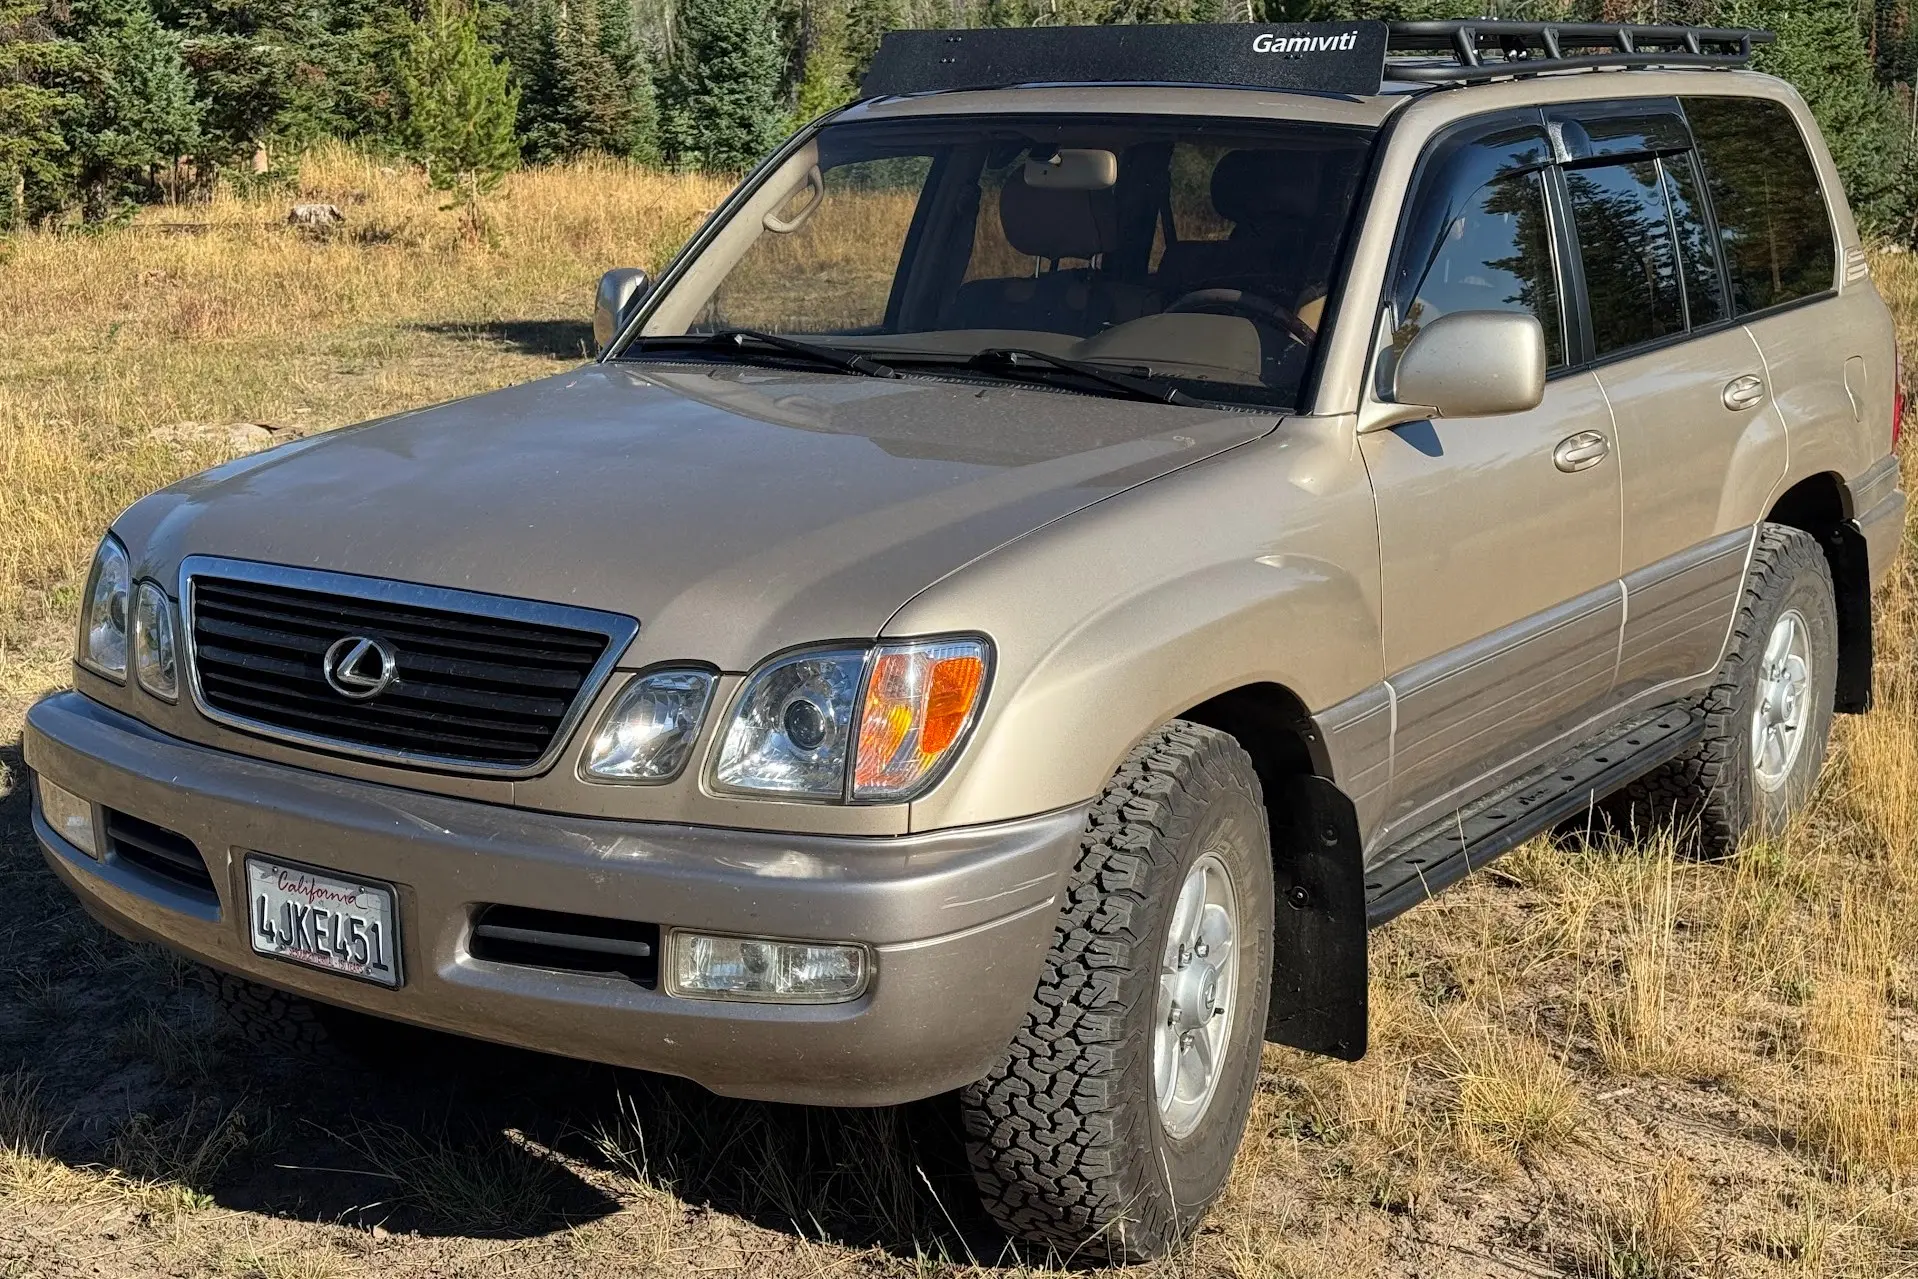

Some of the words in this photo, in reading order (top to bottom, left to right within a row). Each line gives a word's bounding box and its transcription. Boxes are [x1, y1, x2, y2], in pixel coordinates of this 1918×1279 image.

[1252, 30, 1358, 53] Gamiviti
[277, 870, 361, 907] California
[256, 893, 389, 972] 4JKE451
